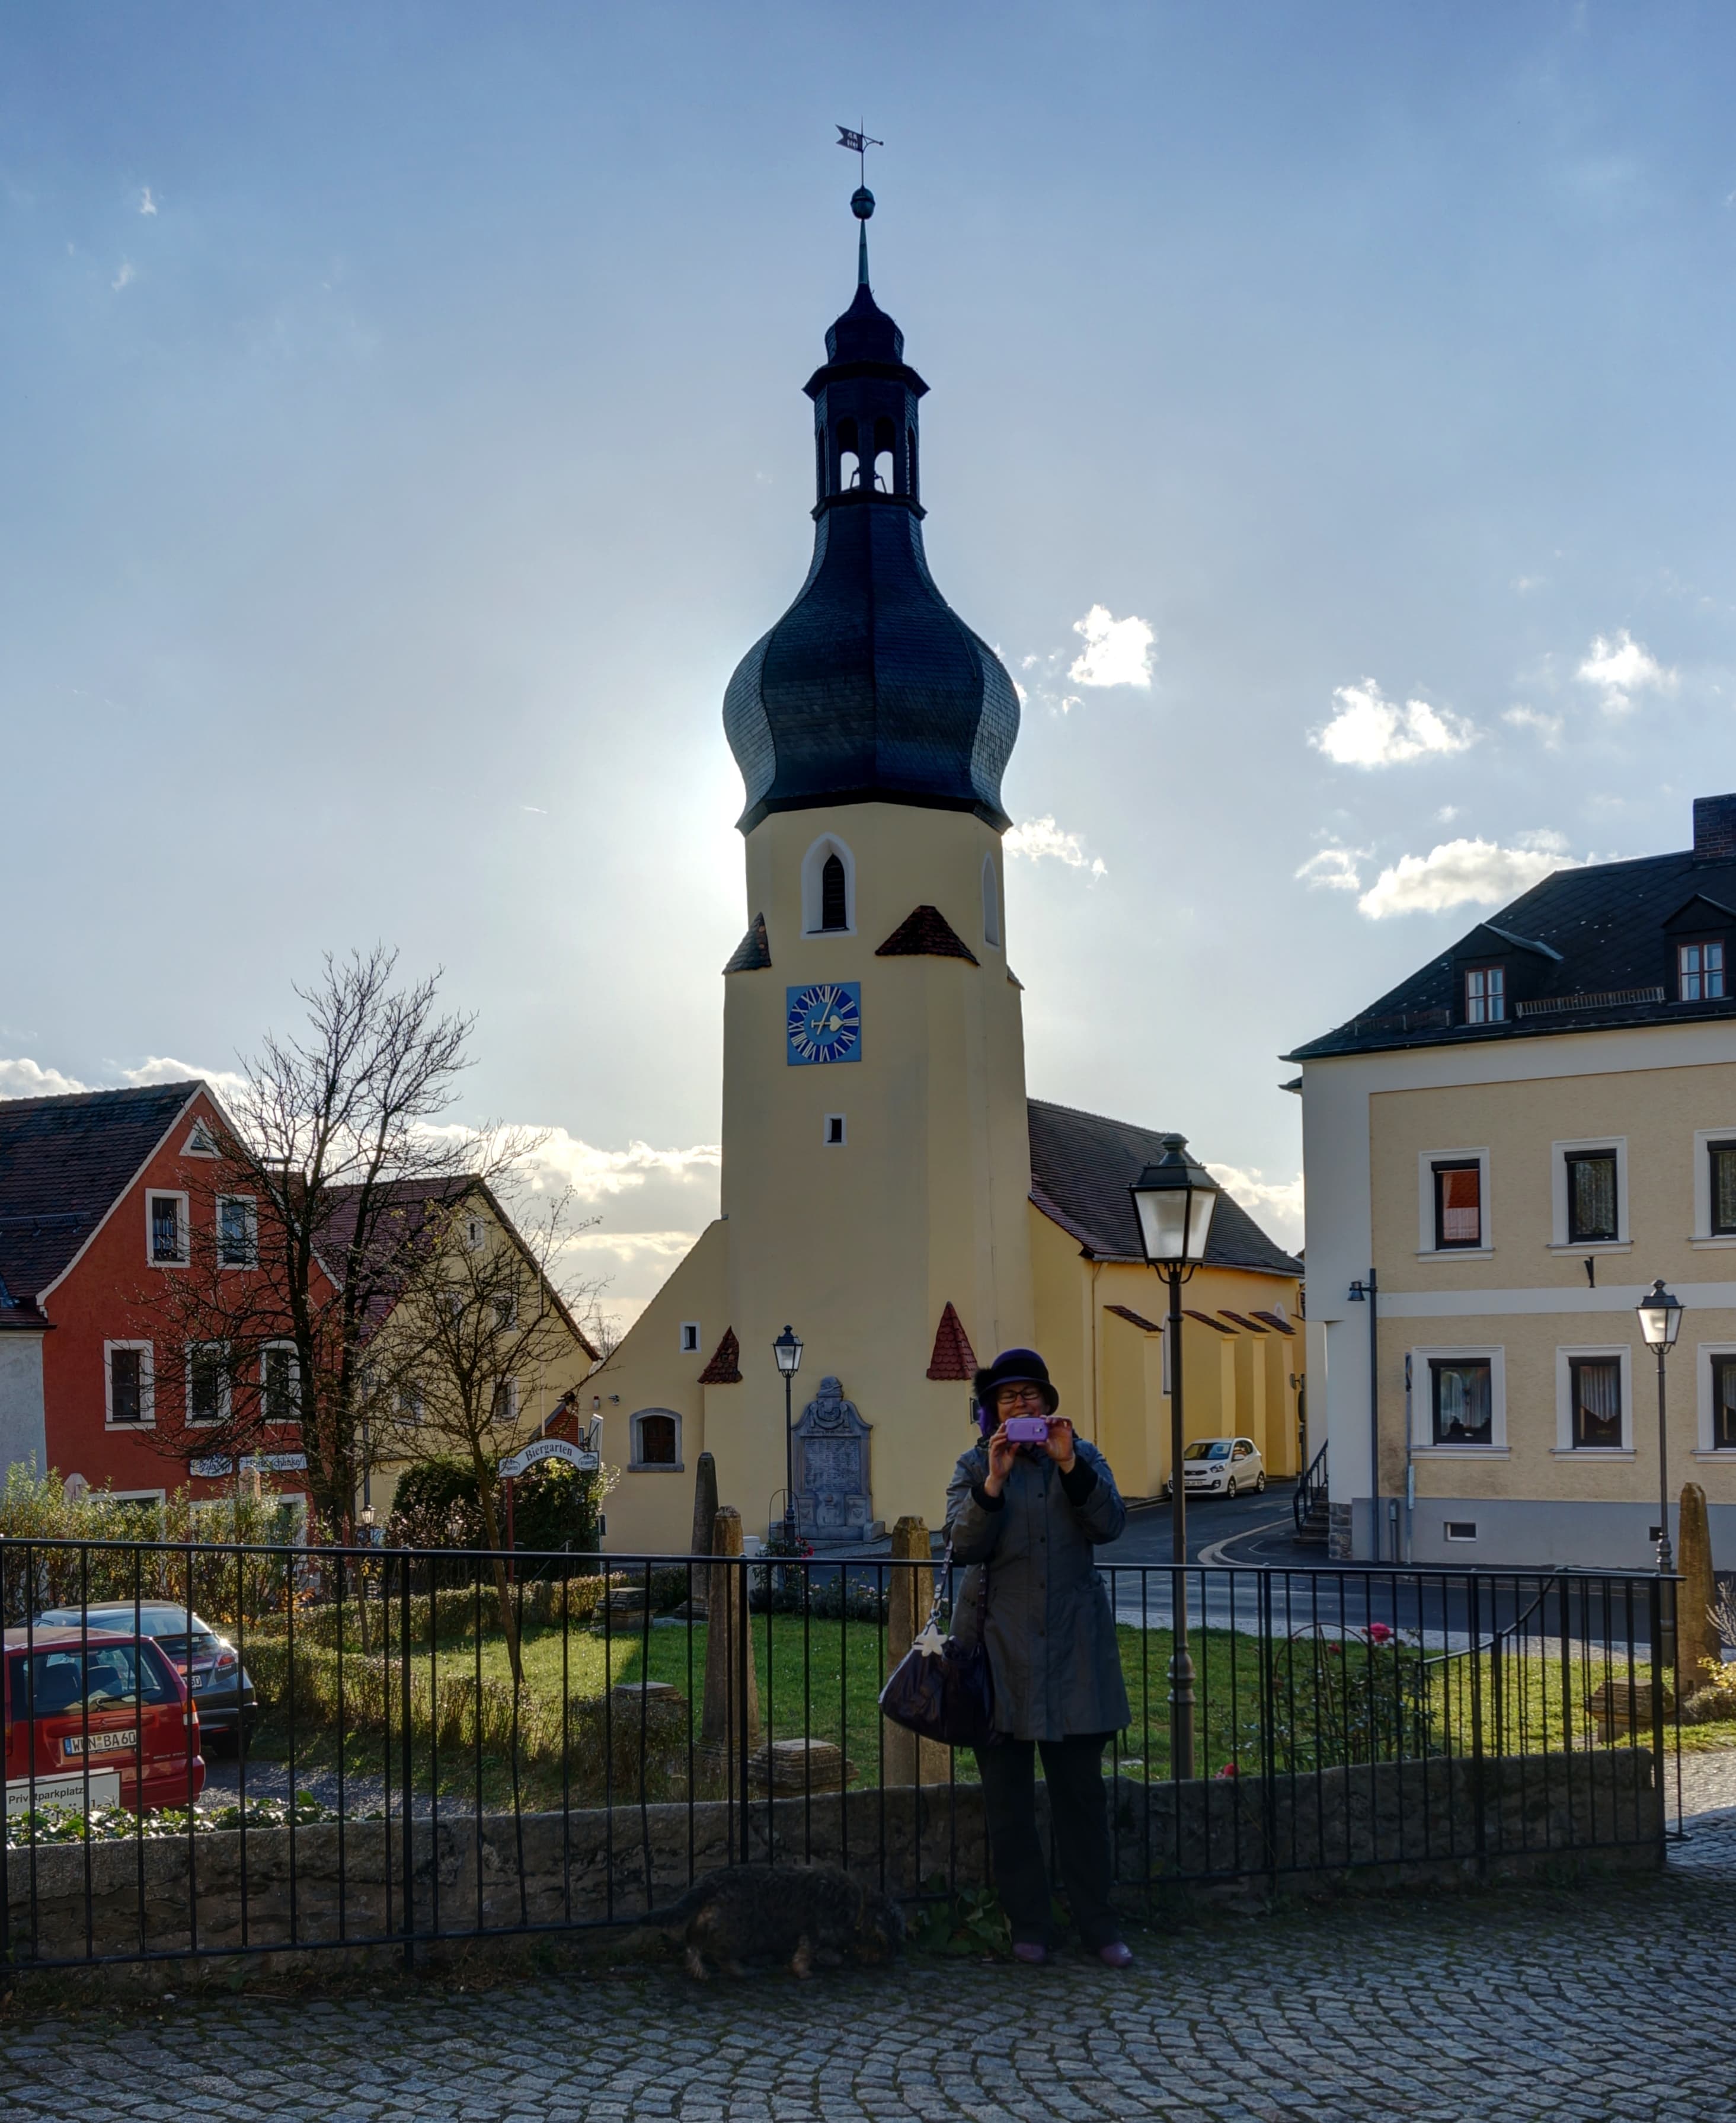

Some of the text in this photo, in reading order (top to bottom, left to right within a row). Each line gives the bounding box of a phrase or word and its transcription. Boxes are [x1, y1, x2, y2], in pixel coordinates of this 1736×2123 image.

[525, 1444, 573, 1461] Biergarten
[104, 1733, 119, 1747] BA
[9, 1787, 84, 1804] Privtparkplatz
